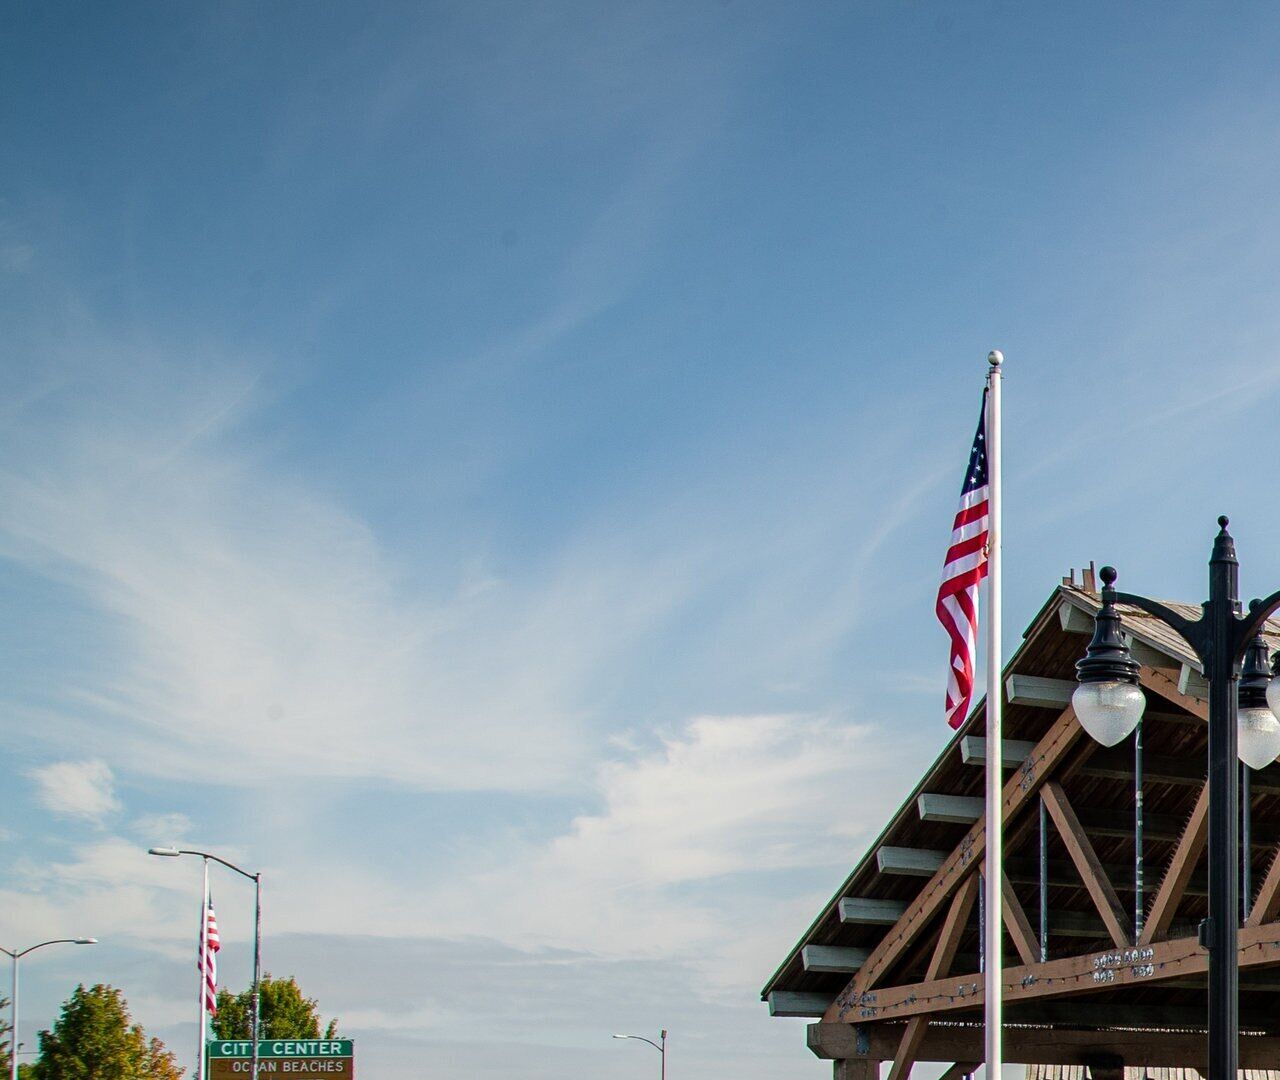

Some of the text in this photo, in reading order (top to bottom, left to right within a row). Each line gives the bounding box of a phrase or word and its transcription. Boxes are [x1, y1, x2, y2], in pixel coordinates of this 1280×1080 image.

[272, 1042, 342, 1055] CENTER
[232, 1061, 343, 1072] OCAN BEACHES
